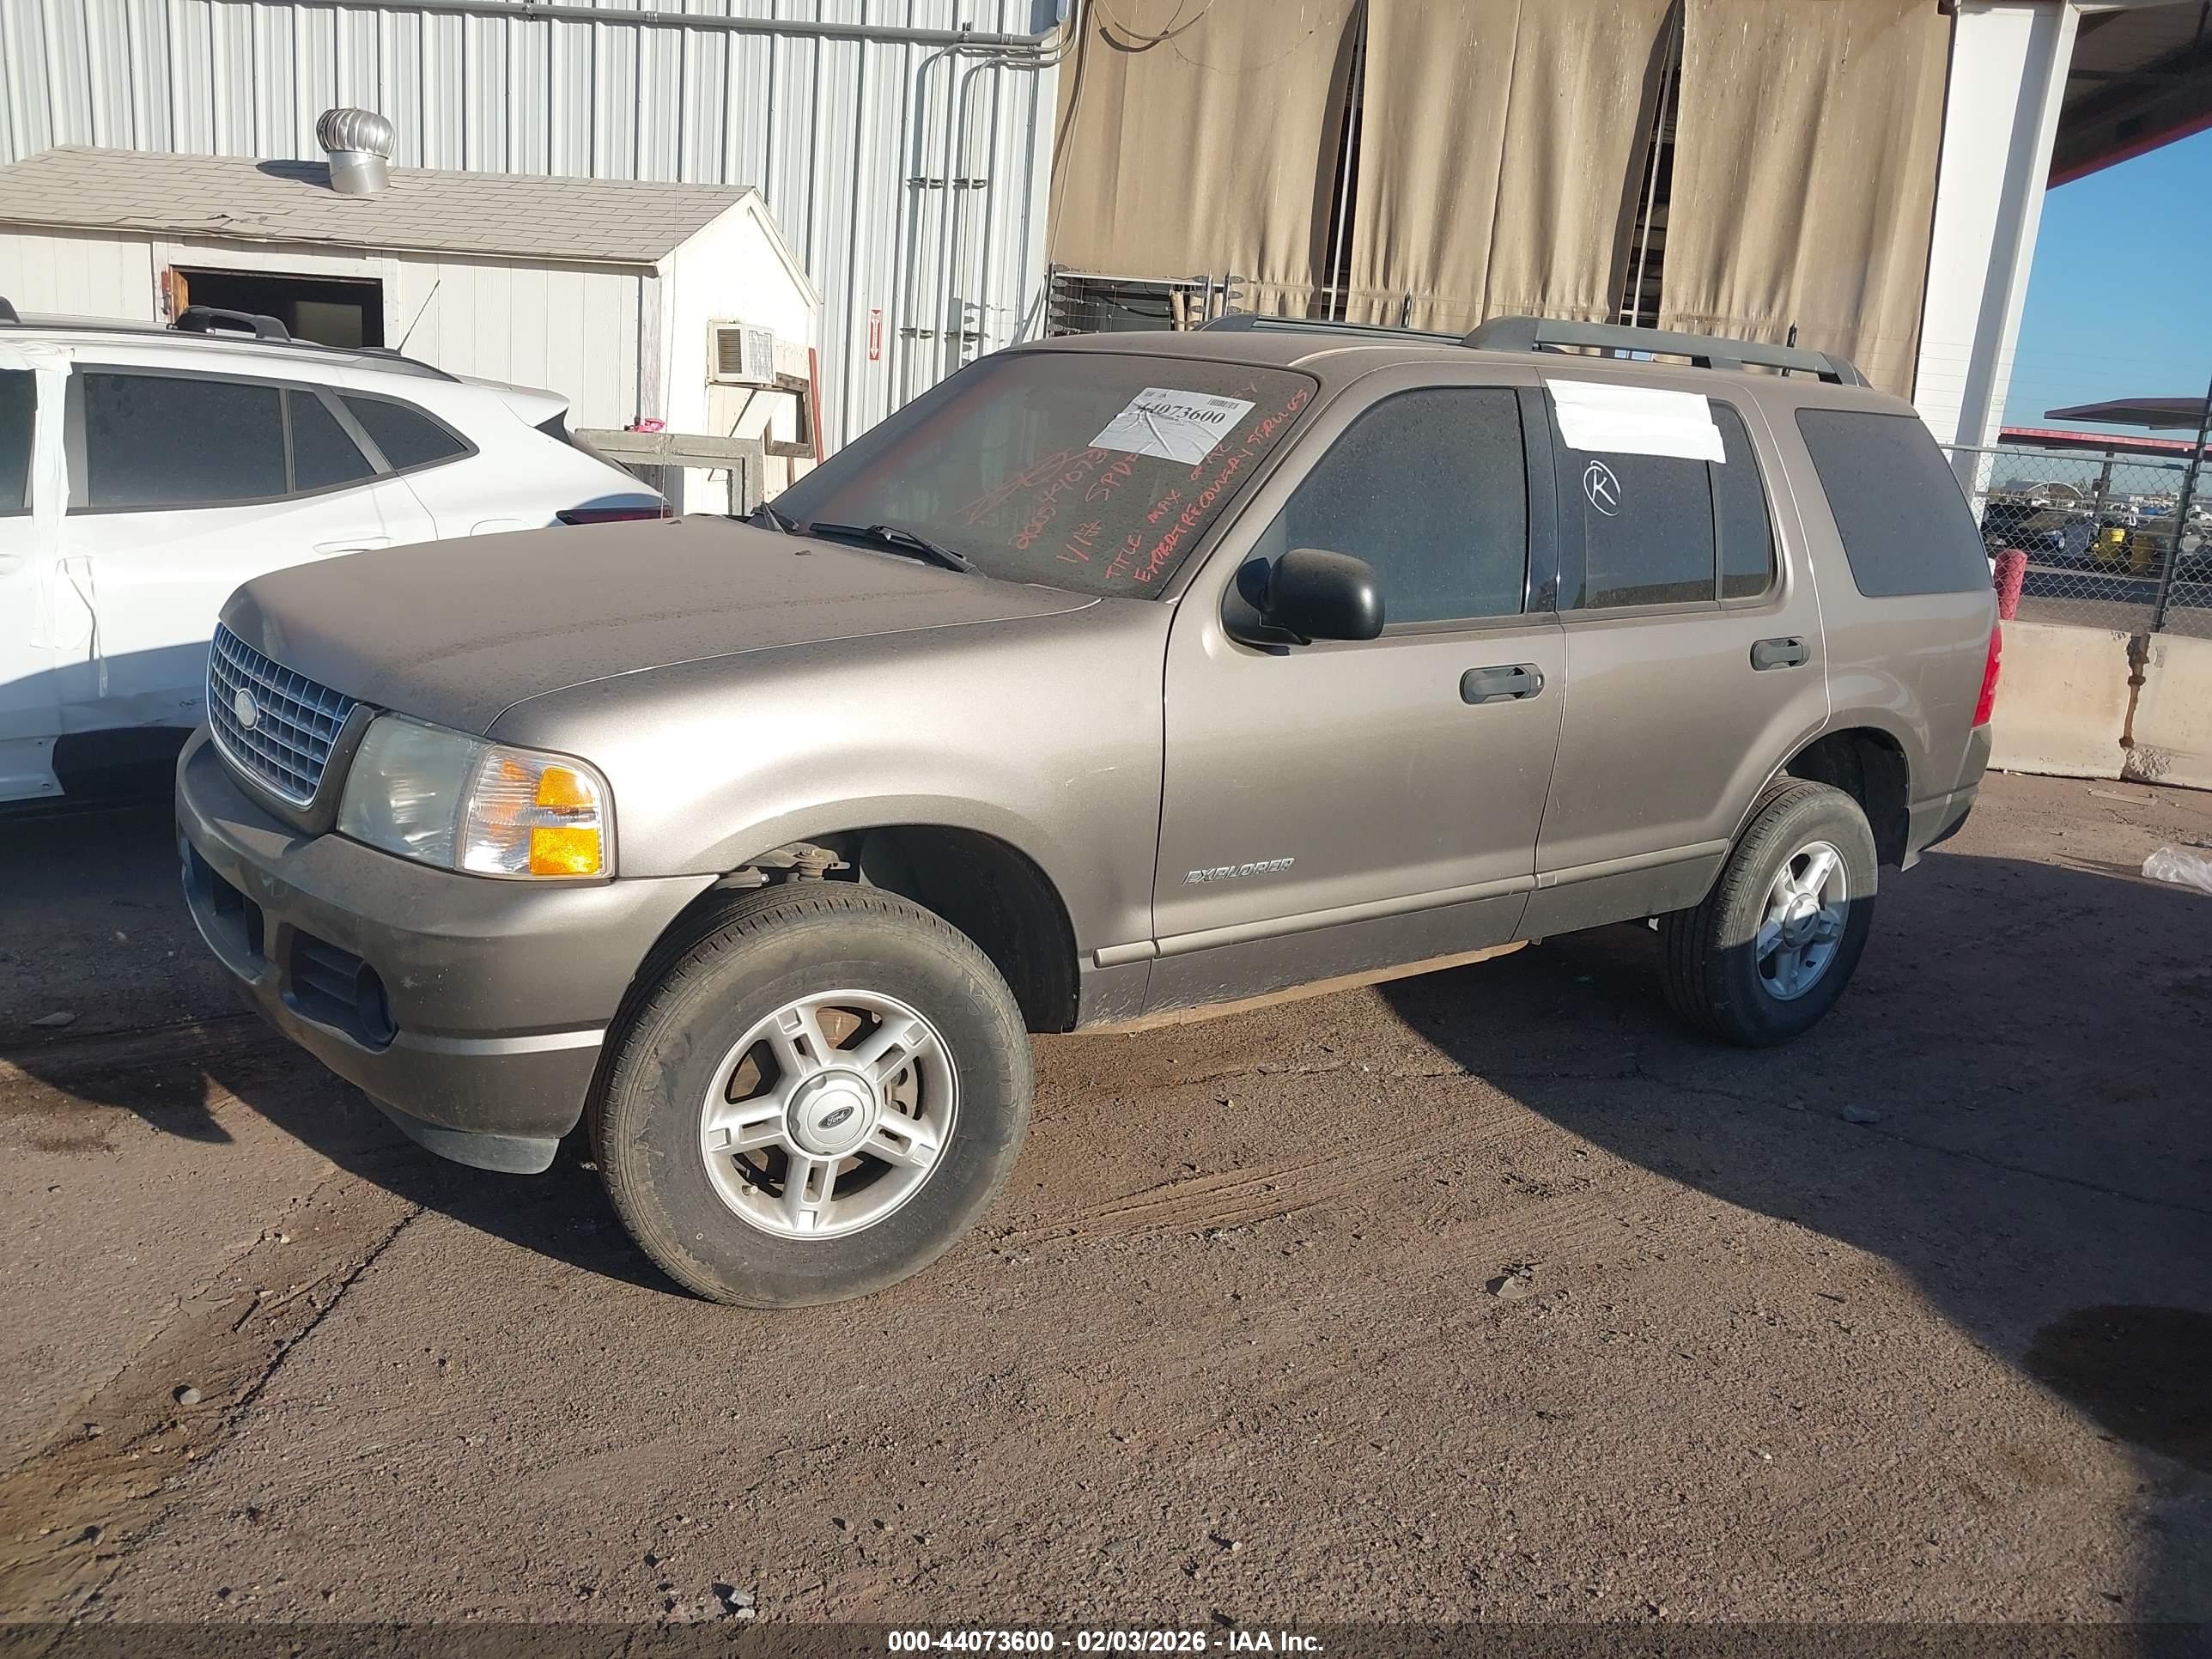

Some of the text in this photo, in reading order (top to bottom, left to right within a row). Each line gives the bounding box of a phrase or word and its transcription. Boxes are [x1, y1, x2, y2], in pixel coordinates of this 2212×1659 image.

[1105, 534, 1141, 579] TITLE
[1146, 489, 1181, 524] MAX
[1181, 857, 1296, 886] EXPLORER
